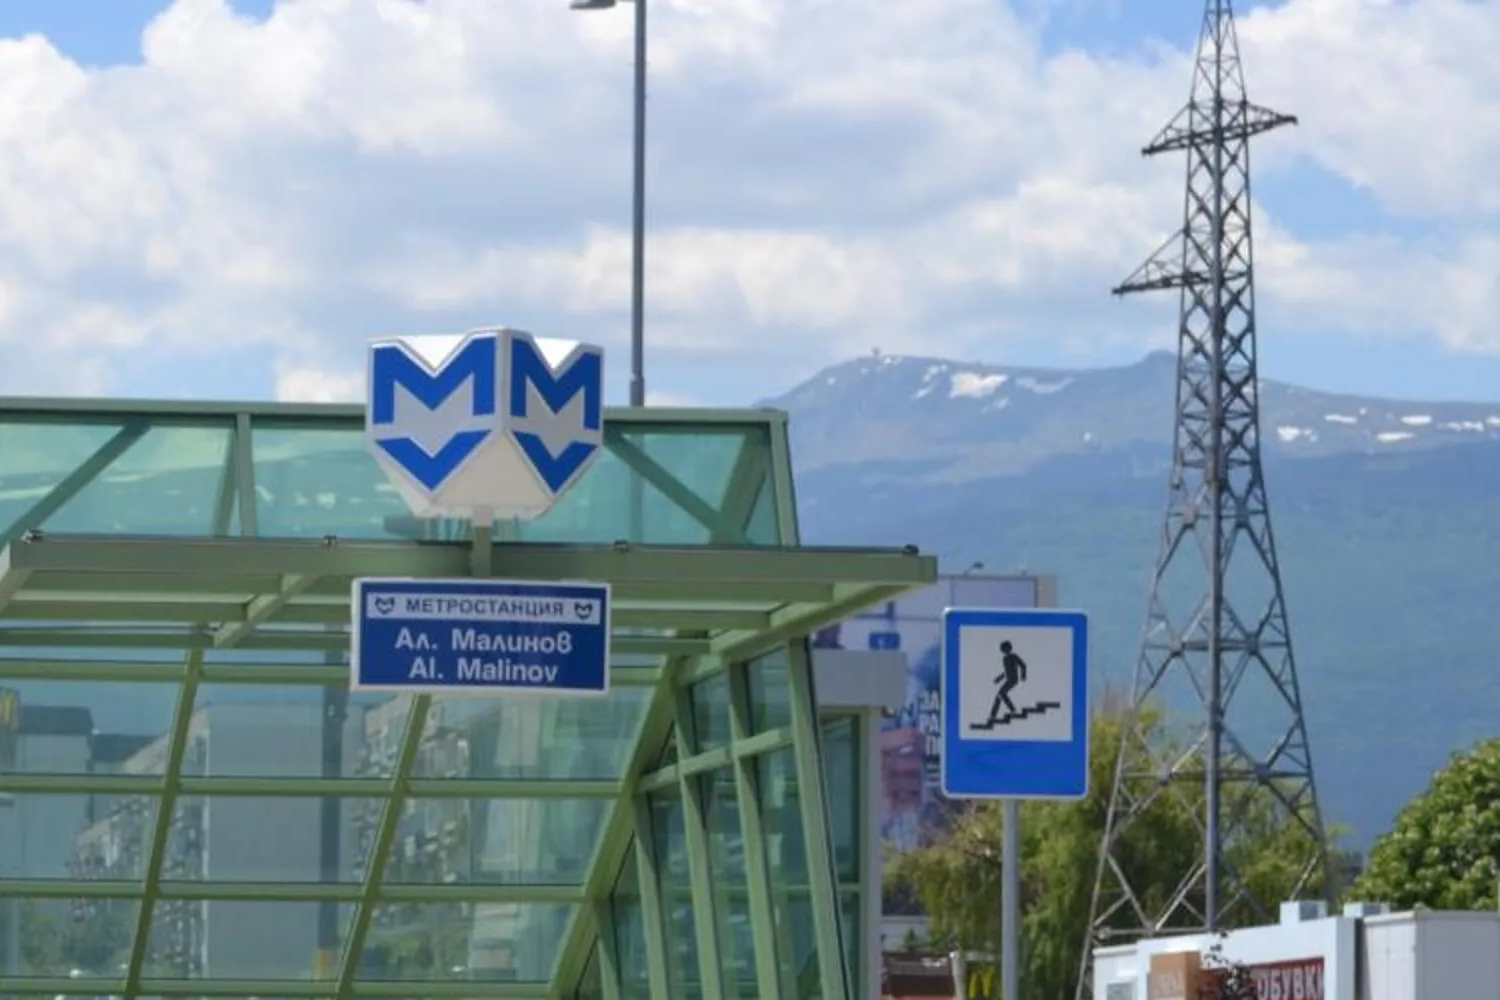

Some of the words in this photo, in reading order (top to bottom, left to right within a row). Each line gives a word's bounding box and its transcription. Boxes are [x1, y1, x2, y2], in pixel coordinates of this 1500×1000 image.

[405, 598, 565, 617] МЕТРОСТАНЦИЯ
[394, 627, 438, 650] Ал.
[451, 628, 573, 655] Малинов
[408, 656, 443, 680] Al.
[457, 657, 559, 683] Malinov
